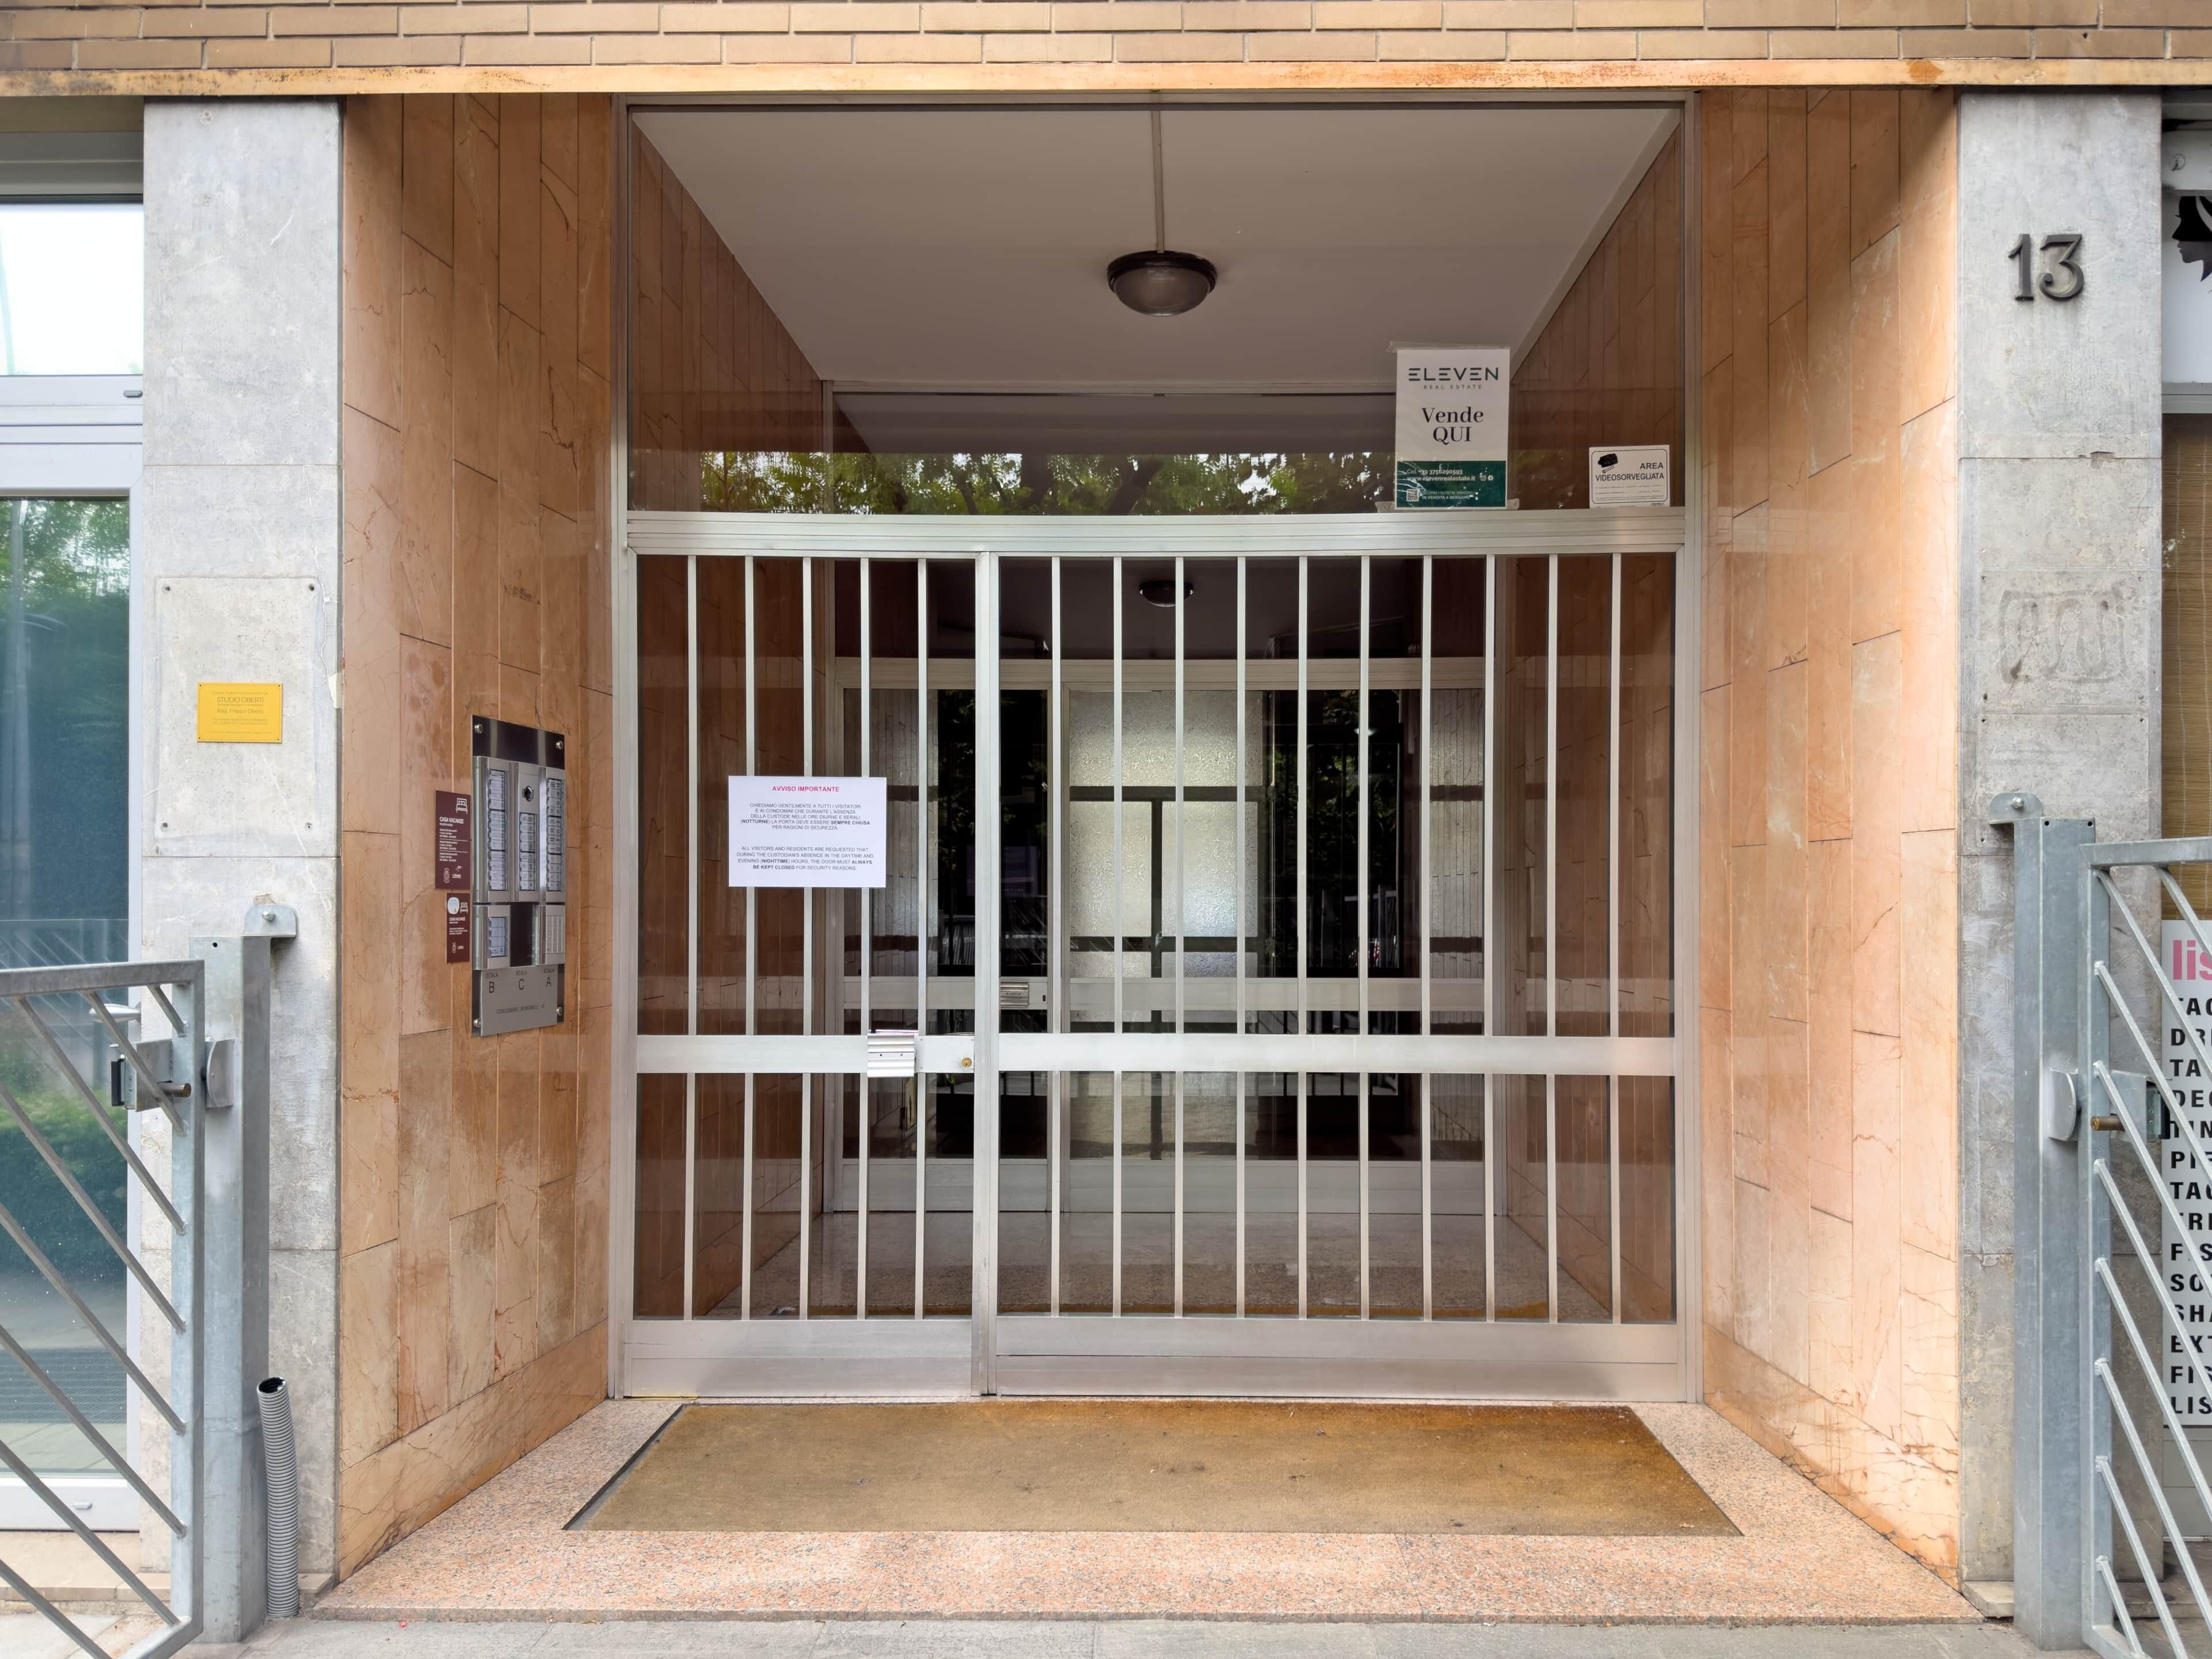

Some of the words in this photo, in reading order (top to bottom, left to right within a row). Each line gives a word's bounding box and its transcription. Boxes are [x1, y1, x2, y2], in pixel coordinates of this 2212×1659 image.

[2008, 233, 2084, 301] 13
[1408, 368, 1498, 381] ELEVEN
[1422, 406, 1484, 423] Vende
[1433, 426, 1471, 445] QUI
[1596, 473, 1664, 481] VIDEOSORVEGLIATA
[489, 982, 495, 993] B
[518, 979, 525, 990] C
[546, 976, 552, 987] A
